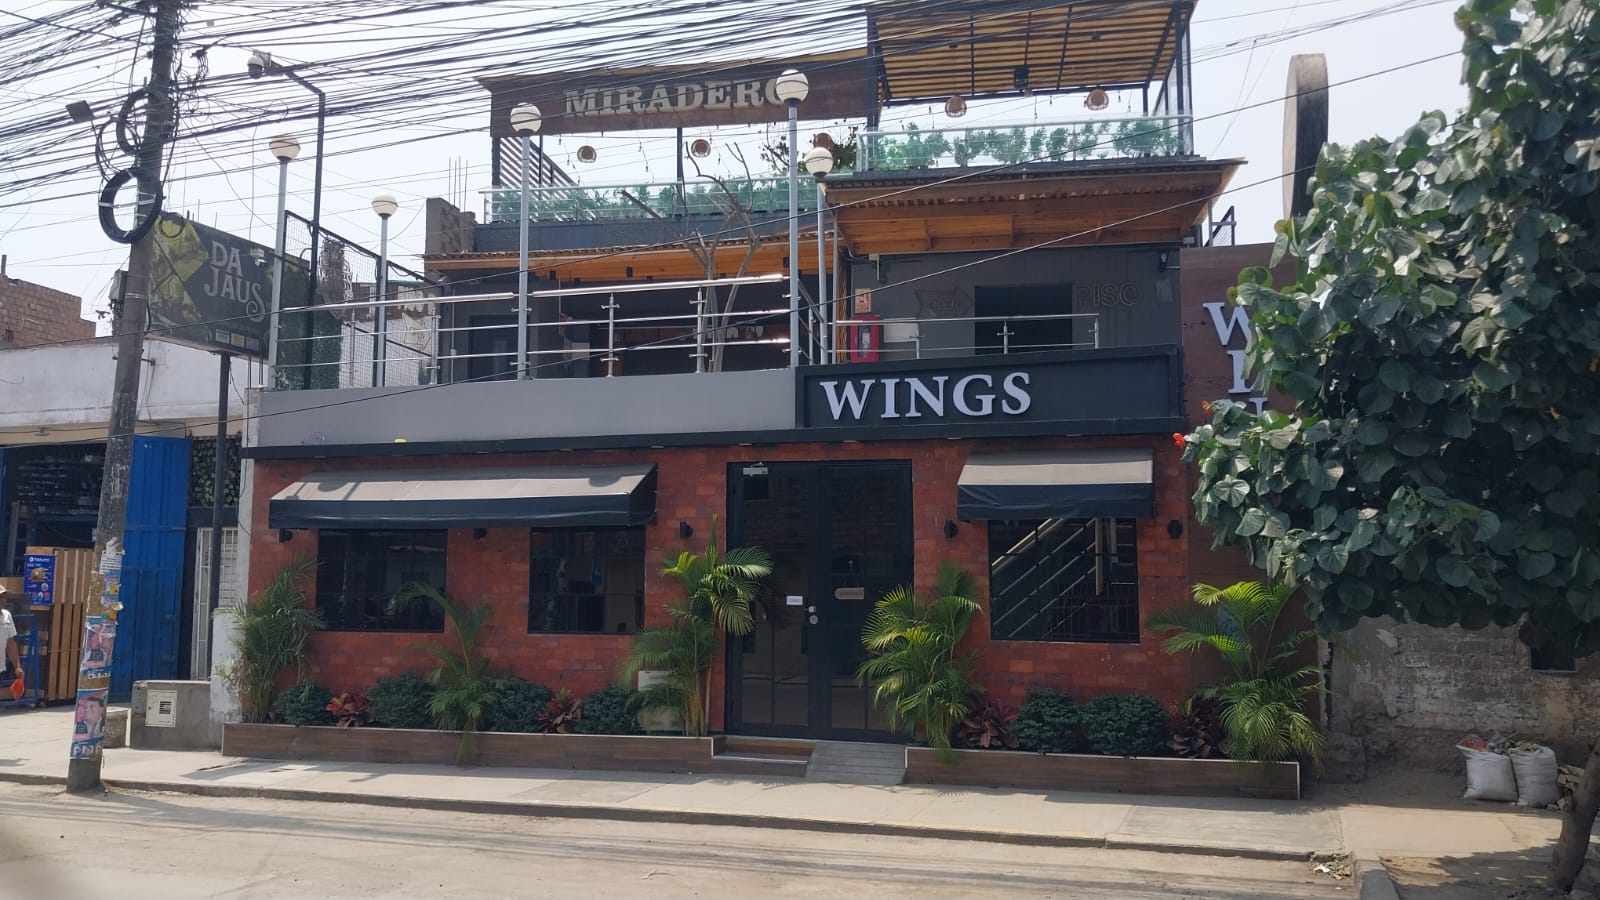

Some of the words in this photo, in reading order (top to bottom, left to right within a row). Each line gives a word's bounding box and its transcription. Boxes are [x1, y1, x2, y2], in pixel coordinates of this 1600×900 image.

[210, 240, 243, 277] DA
[204, 266, 266, 322] JAUS
[1203, 302, 1268, 416] WI
[819, 371, 1031, 420] WINGS
